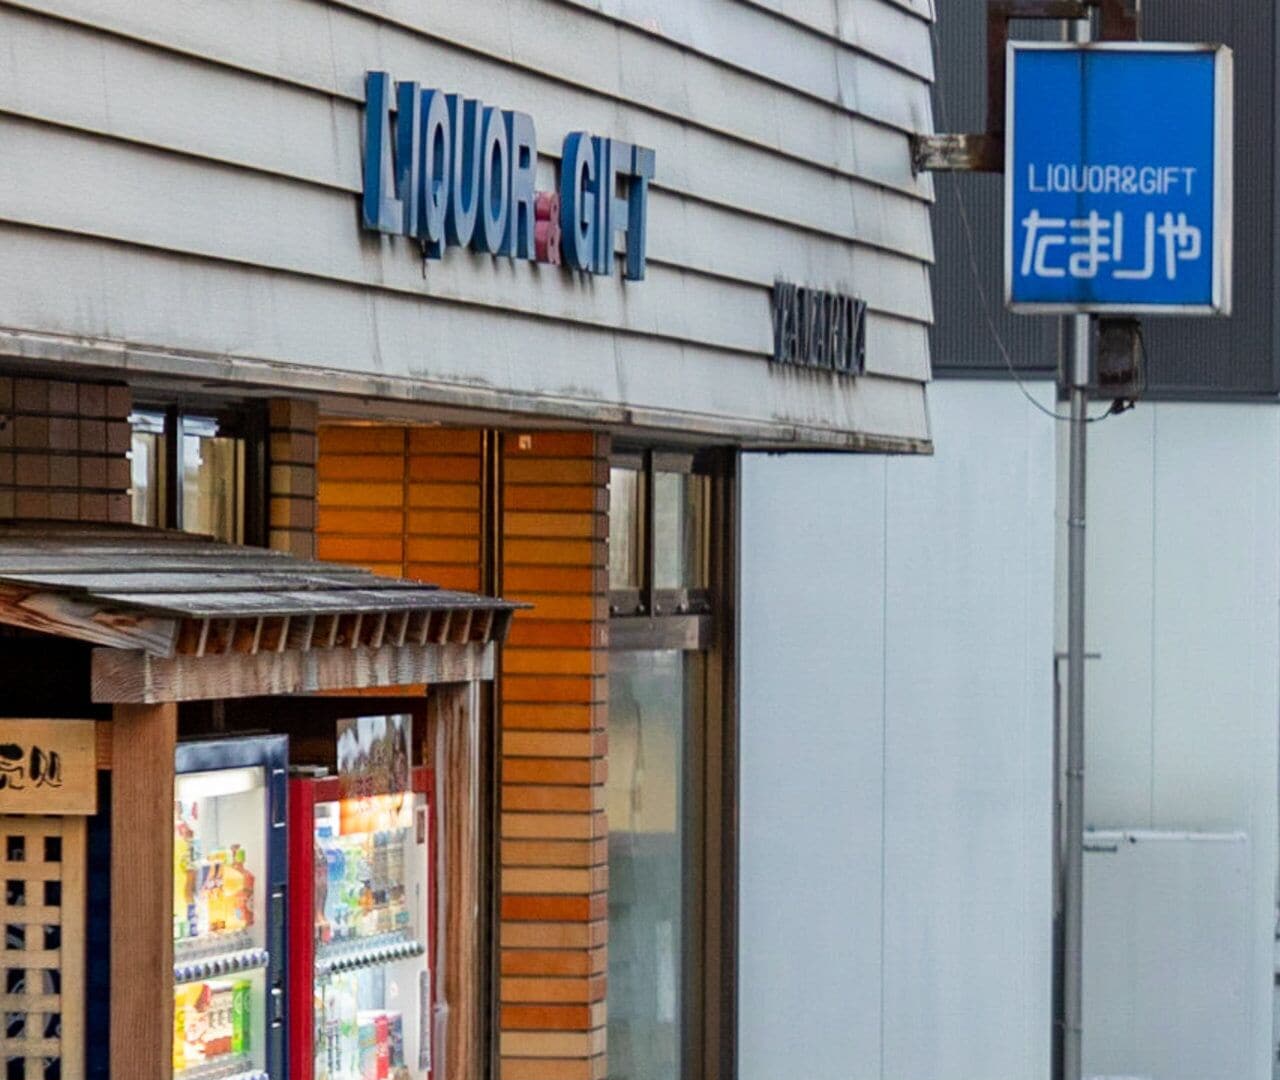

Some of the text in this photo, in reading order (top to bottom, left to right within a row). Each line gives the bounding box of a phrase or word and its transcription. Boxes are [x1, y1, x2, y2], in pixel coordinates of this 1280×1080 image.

[363, 71, 655, 281] LIQUOR & GIFT
[1029, 163, 1196, 195] LIQUOR&GIFT
[1021, 208, 1201, 281] たまりや
